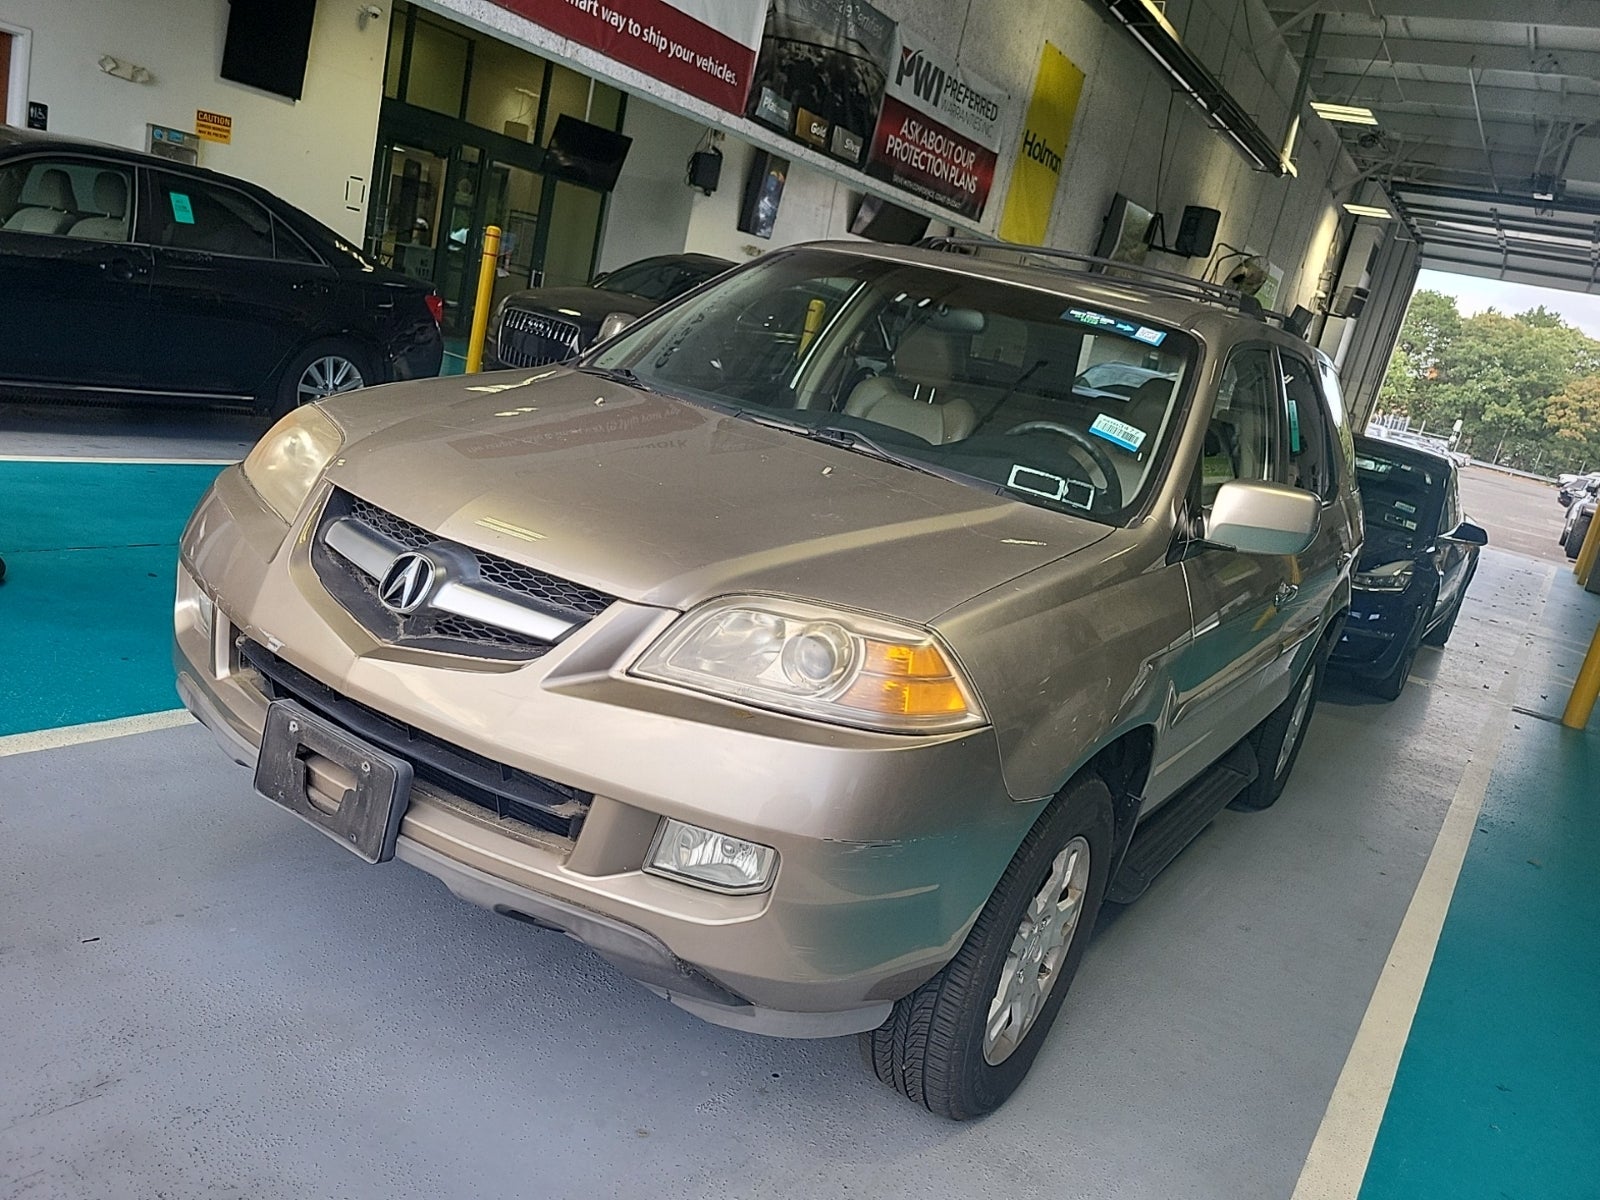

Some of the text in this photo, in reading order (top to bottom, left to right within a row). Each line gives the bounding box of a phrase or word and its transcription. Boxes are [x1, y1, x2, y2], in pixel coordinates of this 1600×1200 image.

[601, 6, 626, 33] way
[628, 17, 641, 37] to
[642, 26, 668, 53] ship
[667, 41, 695, 64] your
[696, 55, 738, 86] vehicles.
[895, 46, 946, 107] PWI
[943, 75, 998, 122] PREFERRED
[198, 112, 231, 126] CAUTION
[810, 122, 828, 138] Gold
[885, 134, 979, 194] PROTECTION PLANS
[900, 118, 976, 171] ASK ABOUT OUR
[1022, 129, 1062, 176] Holman
